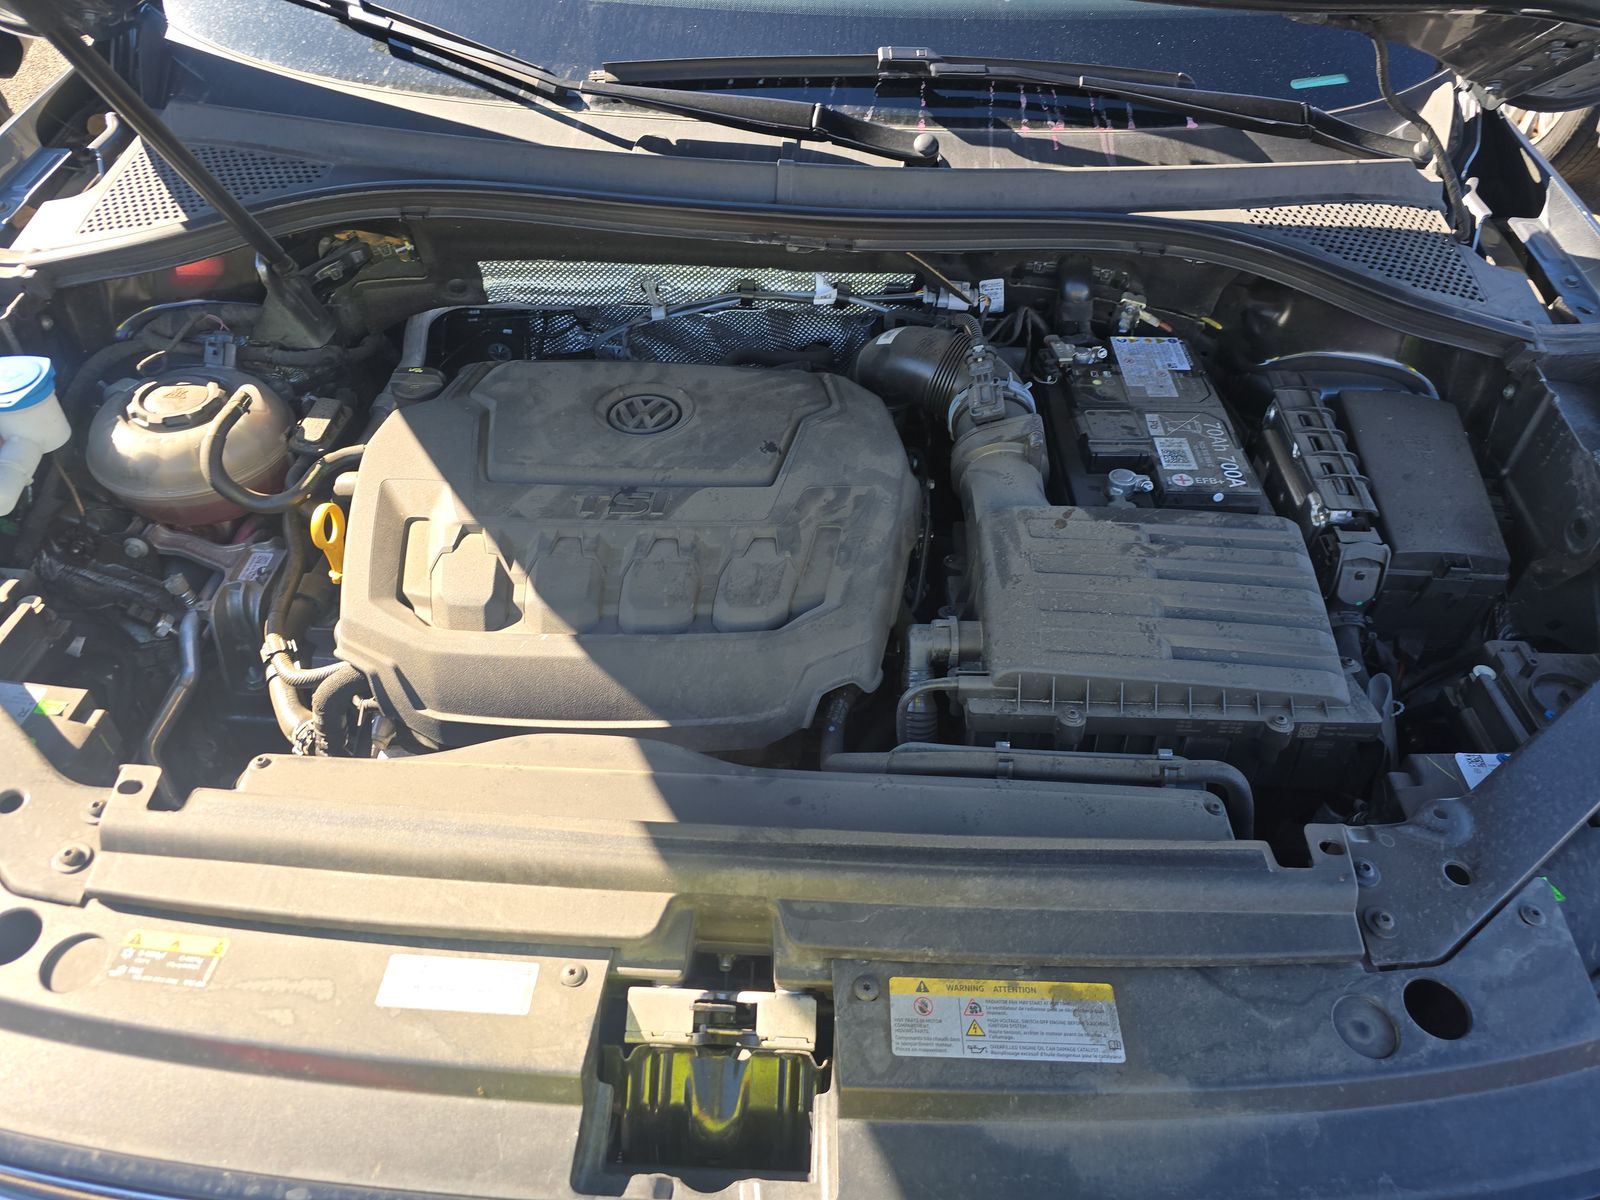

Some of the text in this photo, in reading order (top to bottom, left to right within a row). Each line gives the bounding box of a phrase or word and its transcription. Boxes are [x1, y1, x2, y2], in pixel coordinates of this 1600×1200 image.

[1203, 422, 1230, 452] 70Ah
[1217, 455, 1247, 488] 700A
[1195, 477, 1225, 485] EFB+
[574, 488, 672, 516] TSI
[946, 984, 1037, 994] WARNING ATTENTION
